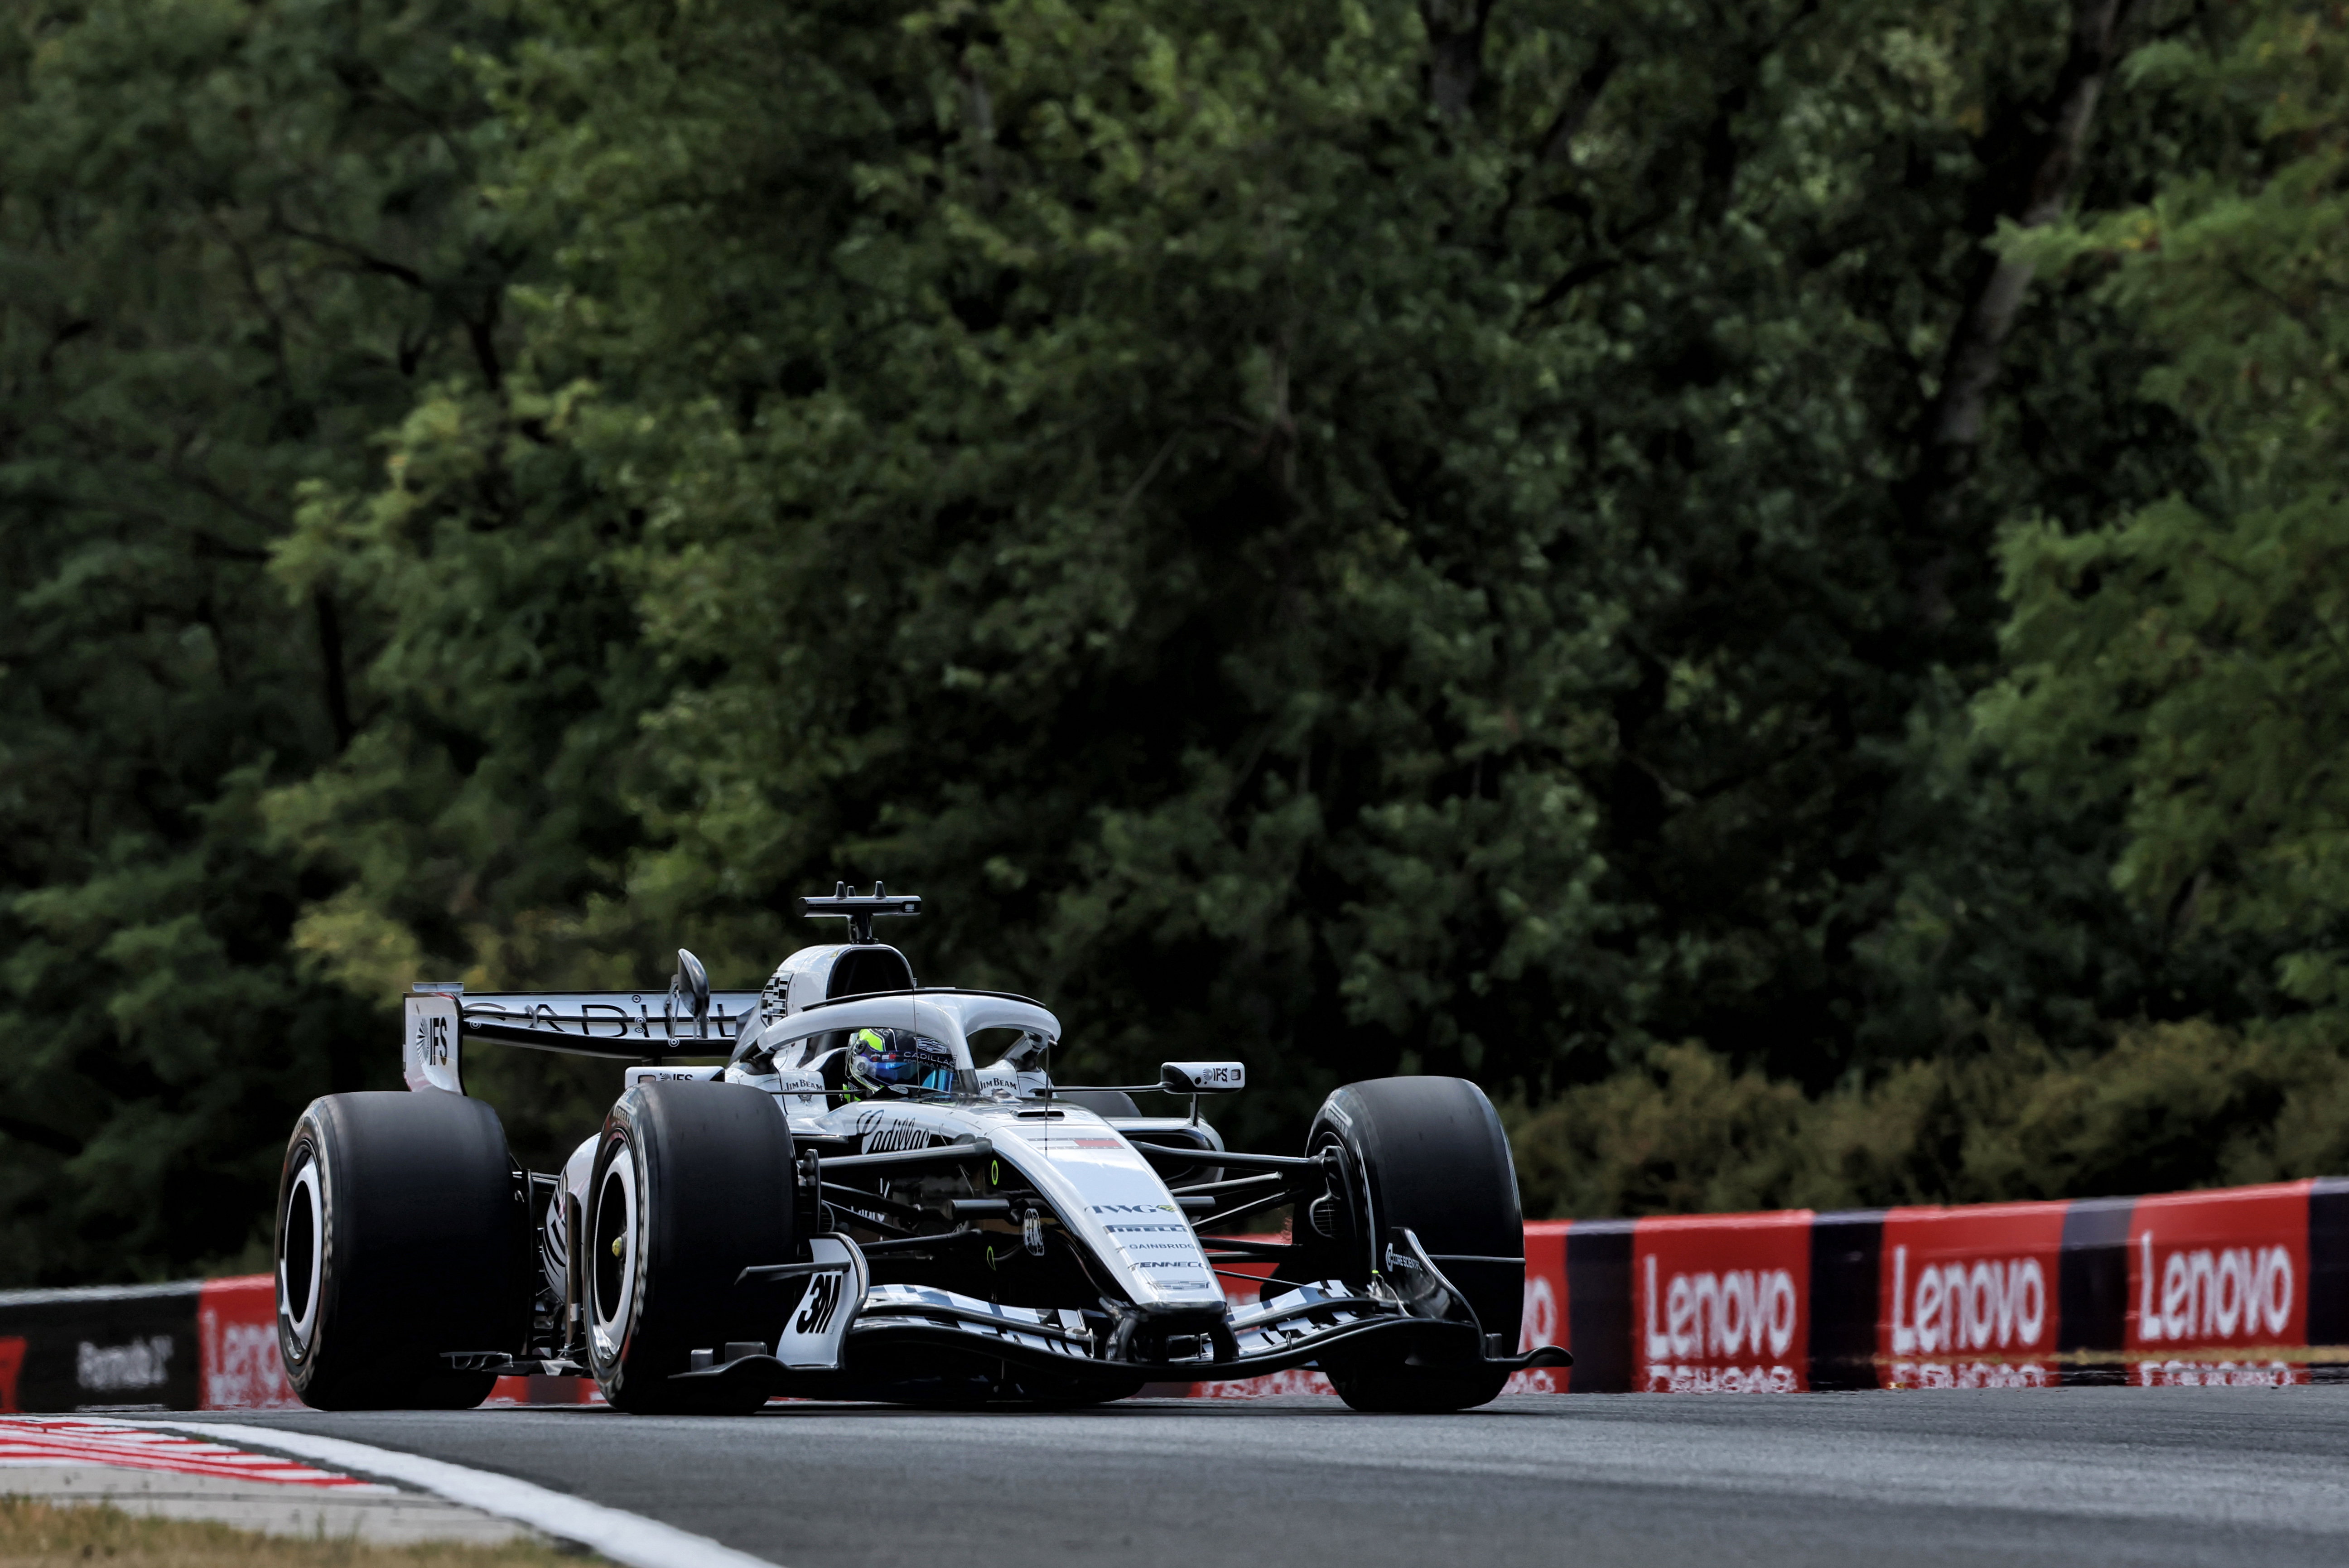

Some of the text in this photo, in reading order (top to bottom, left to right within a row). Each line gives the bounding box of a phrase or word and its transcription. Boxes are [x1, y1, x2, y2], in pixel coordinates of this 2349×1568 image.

[430, 1017, 447, 1066] IFS
[903, 1052, 955, 1067] CADILLAC
[1213, 1068, 1228, 1082] IFS
[784, 1079, 823, 1091] JIM BEAM
[979, 1078, 1017, 1090] JIM BEAM
[856, 1110, 930, 1155] Cadillac
[1085, 1204, 1157, 1214] TWG
[1103, 1224, 1188, 1235] PIRELLI
[1127, 1261, 1209, 1271] TENNECO
[2139, 1230, 2293, 1342] Lenovo
[796, 1274, 841, 1334] 3M
[1645, 1254, 1797, 1360] Lenovo
[1892, 1244, 2045, 1356] Lenovo
